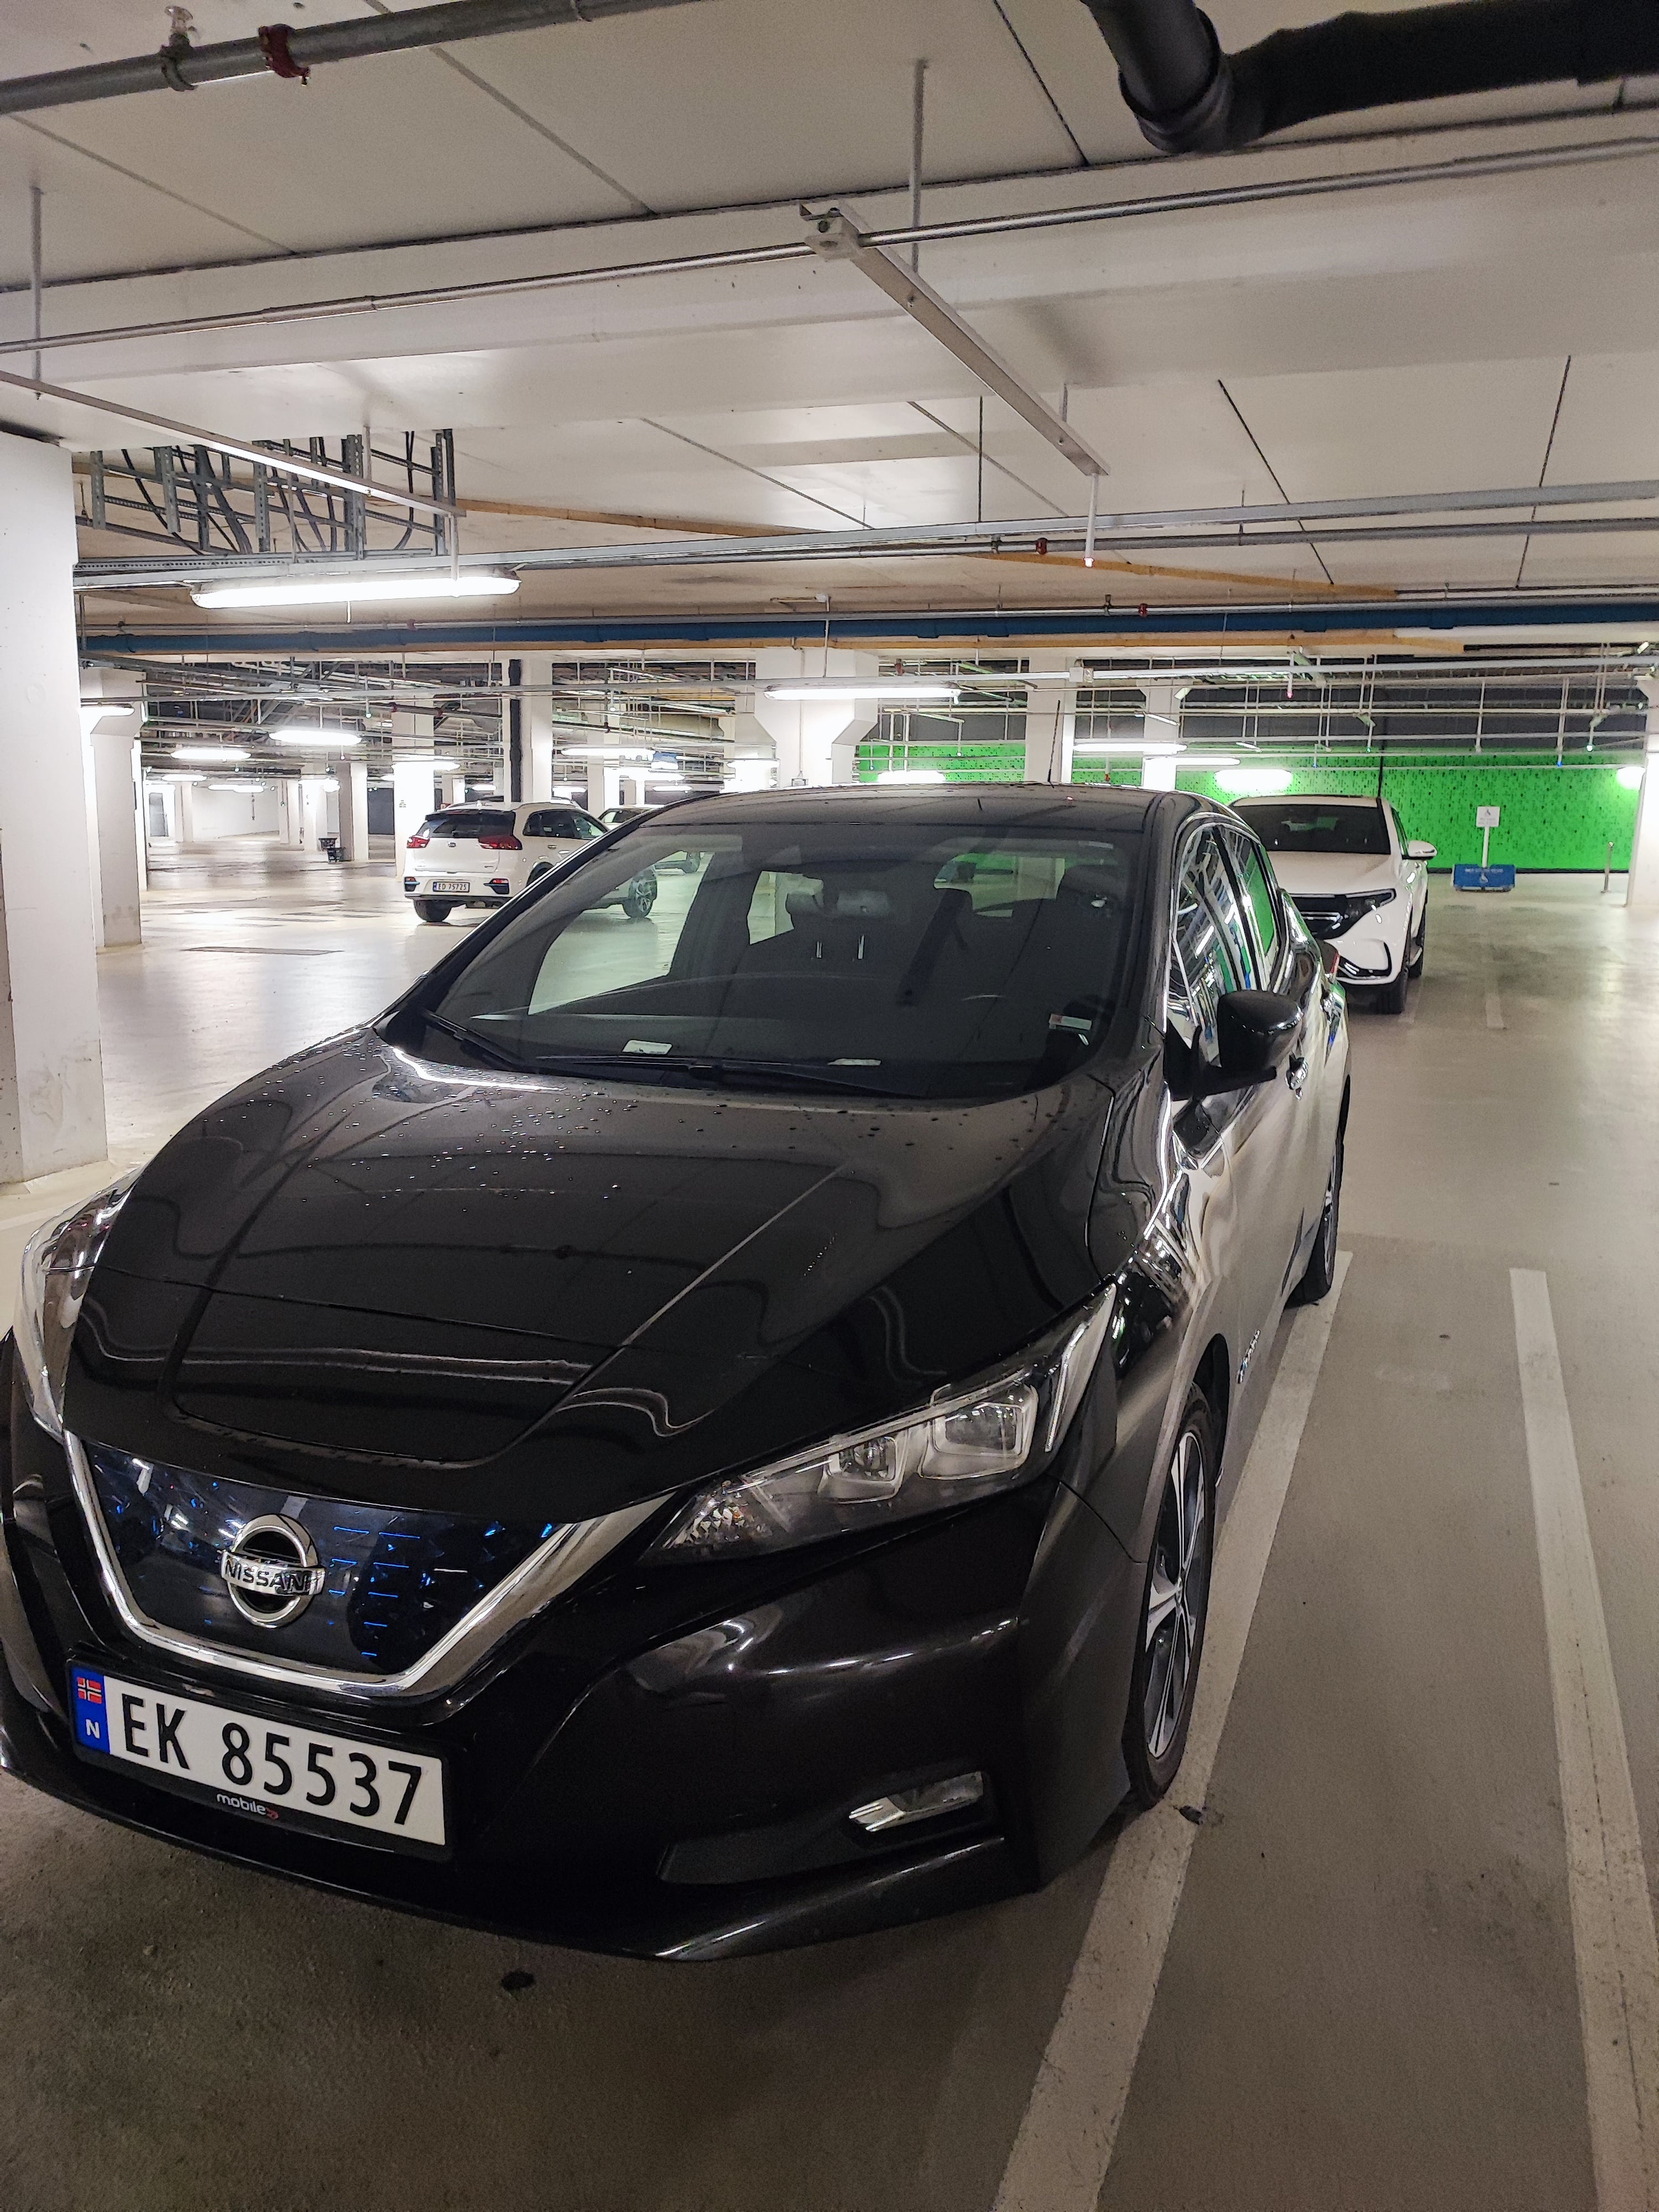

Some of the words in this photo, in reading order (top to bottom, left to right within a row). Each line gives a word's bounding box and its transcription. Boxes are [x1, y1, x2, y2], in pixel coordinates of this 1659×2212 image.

[225, 1554, 313, 1593] NISSAN
[85, 1718, 100, 1739] N
[121, 1693, 190, 1770] EK
[221, 1722, 422, 1825] 85537
